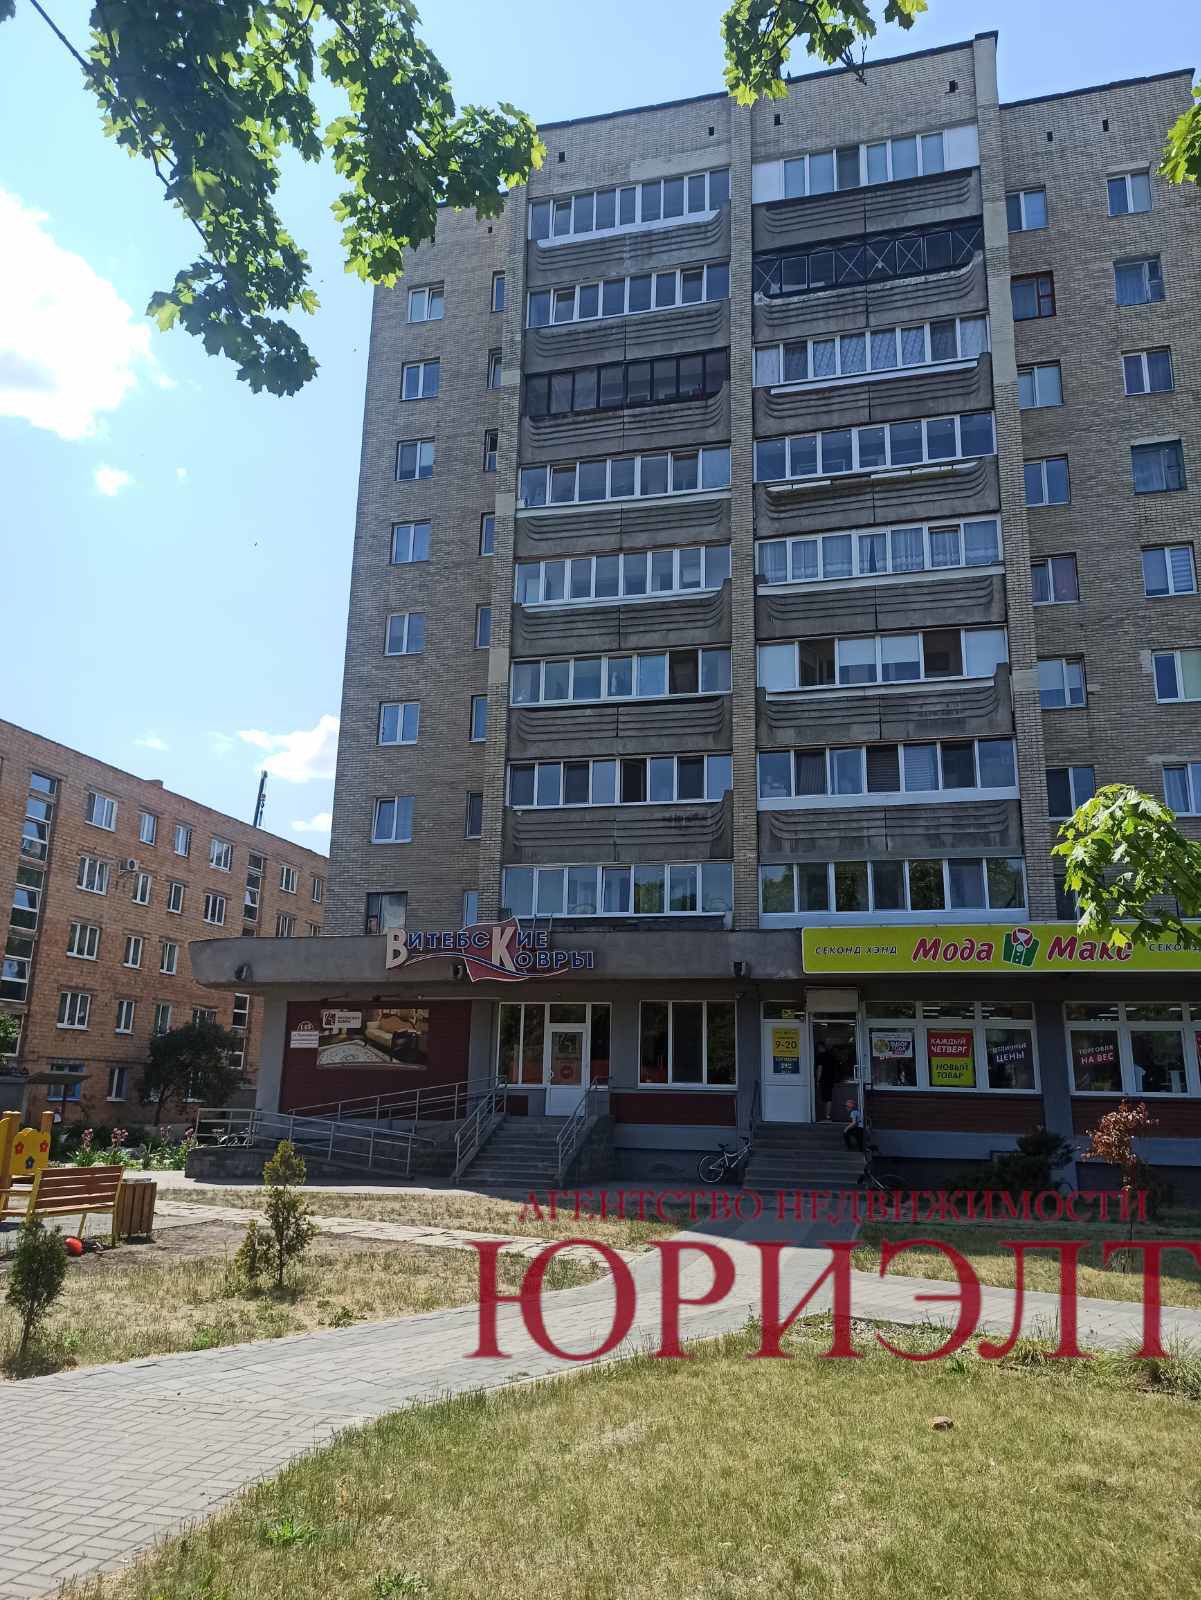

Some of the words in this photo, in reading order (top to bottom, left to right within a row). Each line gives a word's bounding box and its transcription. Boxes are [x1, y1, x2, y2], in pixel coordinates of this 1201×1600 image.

[815, 945, 862, 955] СЕКОНД
[866, 944, 897, 955] ХЭНД
[911, 936, 995, 962] Мода
[1148, 942, 1201, 953] СЕКО
[775, 1040, 797, 1049] 9-20
[930, 1037, 967, 1045] КАЖДЫЙ
[930, 1045, 968, 1054] ЧЕТВЕРГ
[996, 1051, 1025, 1063] ЦЕНЫ
[1080, 1055, 1095, 1064] НА
[1097, 1052, 1115, 1063] ВЕС
[936, 1062, 968, 1071] НОВЫЙ
[936, 1071, 964, 1079] ТОВАР
